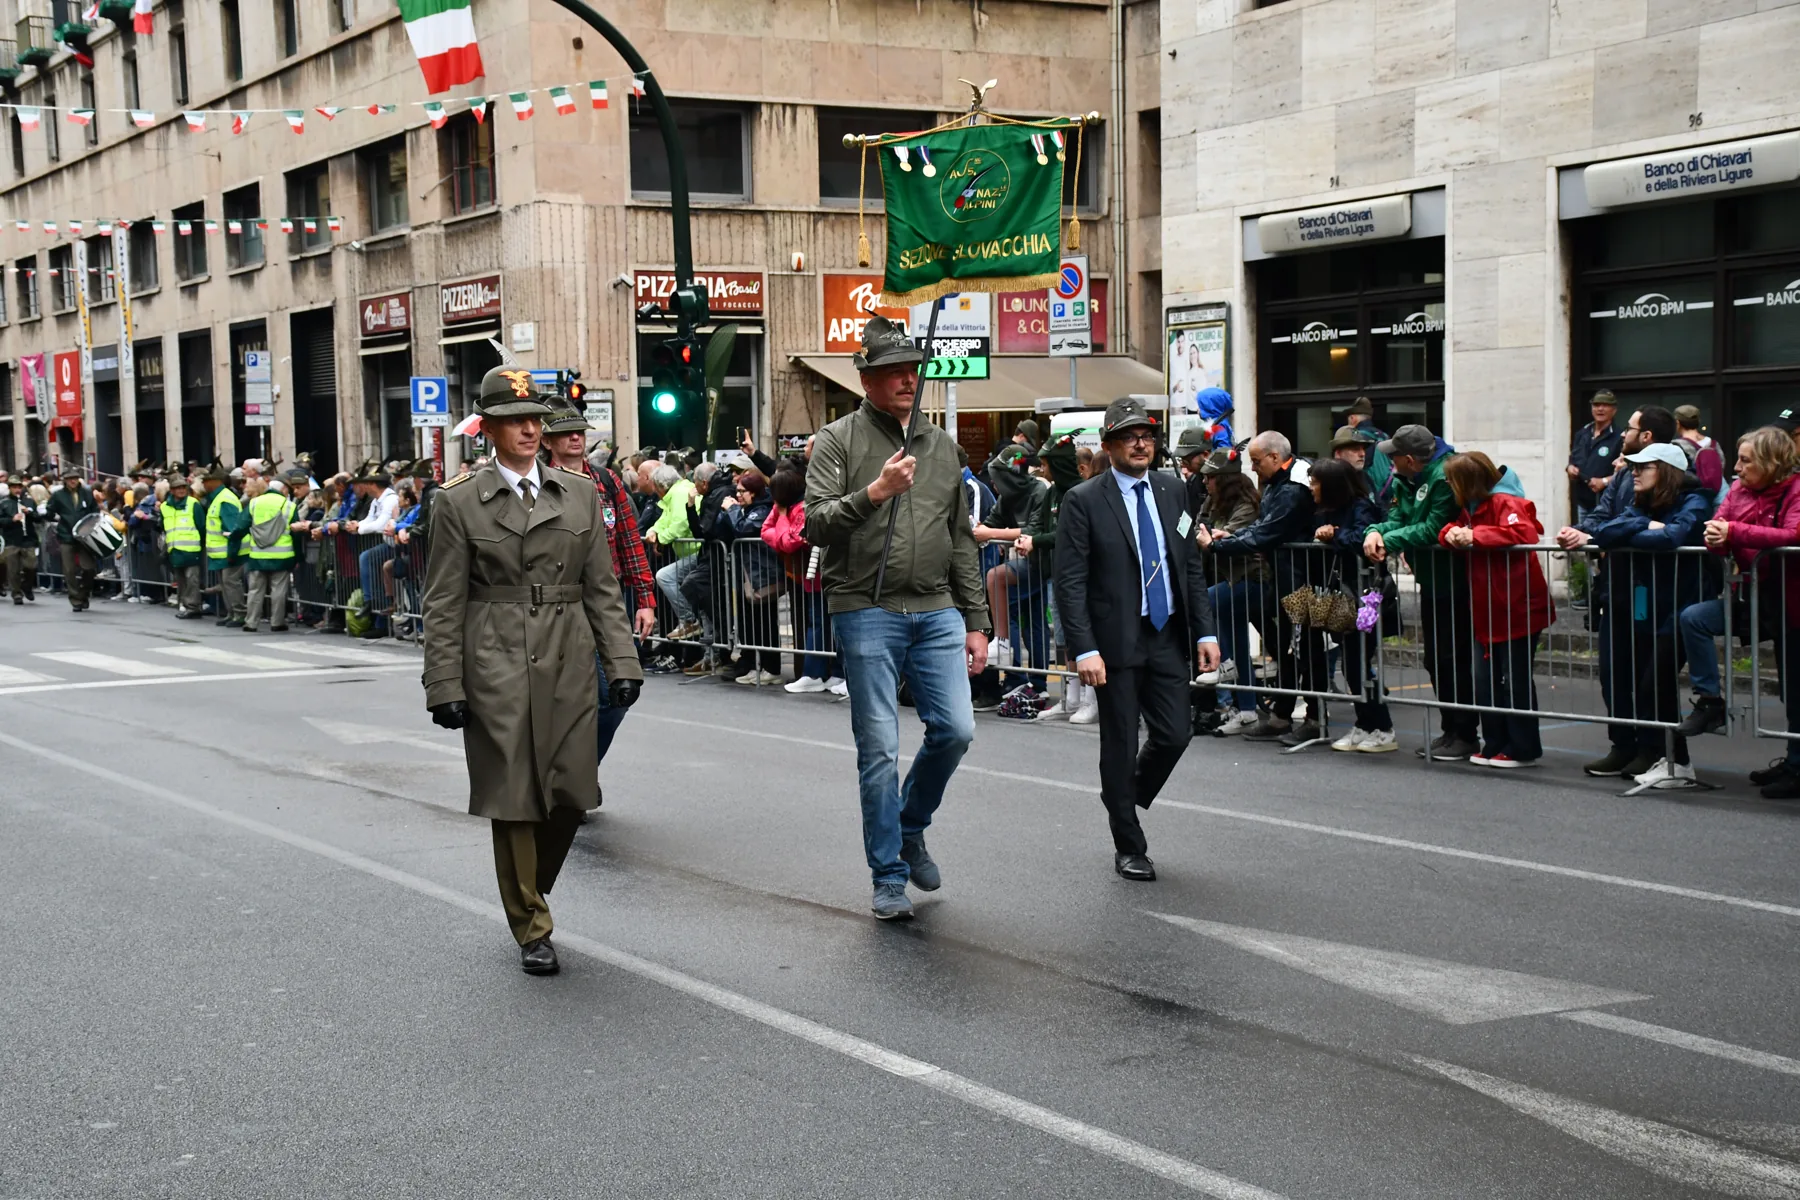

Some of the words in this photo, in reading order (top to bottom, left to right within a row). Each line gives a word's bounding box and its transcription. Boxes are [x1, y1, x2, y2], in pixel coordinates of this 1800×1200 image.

[1689, 112, 1703, 127] 96
[1644, 162, 1685, 178] Banco
[1687, 157, 1699, 171] di
[1700, 148, 1752, 170] Chiavari
[1645, 183, 1652, 192] e
[1654, 177, 1678, 191] della
[1680, 172, 1716, 188] Riviera
[1719, 166, 1753, 185] Ligure
[963, 199, 996, 211] ALPINI
[1298, 215, 1327, 229] Banco
[1328, 213, 1337, 225] di
[1337, 207, 1373, 223] Chiavari
[1306, 230, 1324, 241] della
[1325, 226, 1350, 238] Riviera
[1351, 223, 1375, 236] Ligure
[899, 243, 951, 270] SEZIONE
[952, 233, 1052, 261] SLOVACCHIA
[636, 275, 728, 298] PIZZIA
[727, 280, 760, 296] Basil
[442, 282, 485, 313] PIZZERIA
[723, 301, 760, 309] FOCACCIA
[1618, 303, 1658, 319] BANCO
[1660, 300, 1684, 316] BPM
[1017, 319, 1028, 334] &
[1392, 322, 1424, 336] BANCO
[1425, 320, 1444, 332] BPM
[1292, 330, 1321, 344] BANCO
[1321, 328, 1338, 341] BPM
[934, 348, 969, 358] LIBERO
[418, 380, 440, 410] P
